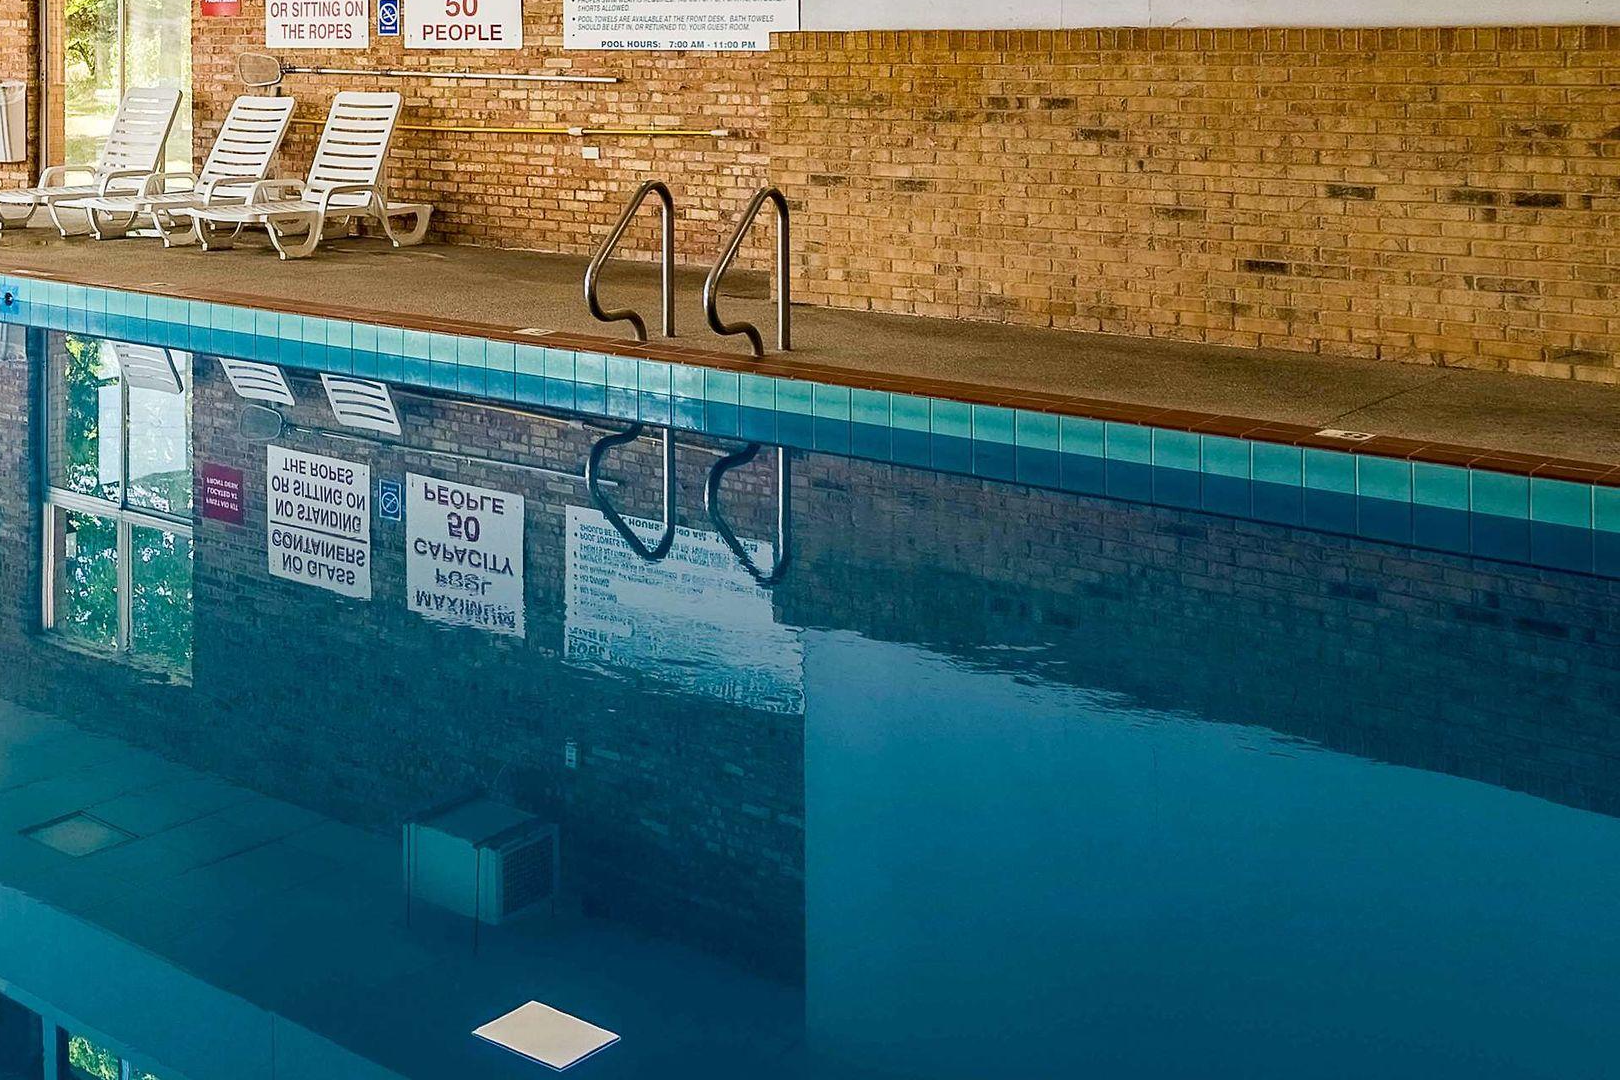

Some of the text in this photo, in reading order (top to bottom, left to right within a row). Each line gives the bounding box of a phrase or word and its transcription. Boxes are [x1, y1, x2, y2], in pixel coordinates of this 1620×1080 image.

[270, 1, 364, 17] OR SITTING ON
[281, 23, 352, 39] THE ROPES
[422, 24, 502, 40] PEOPLE
